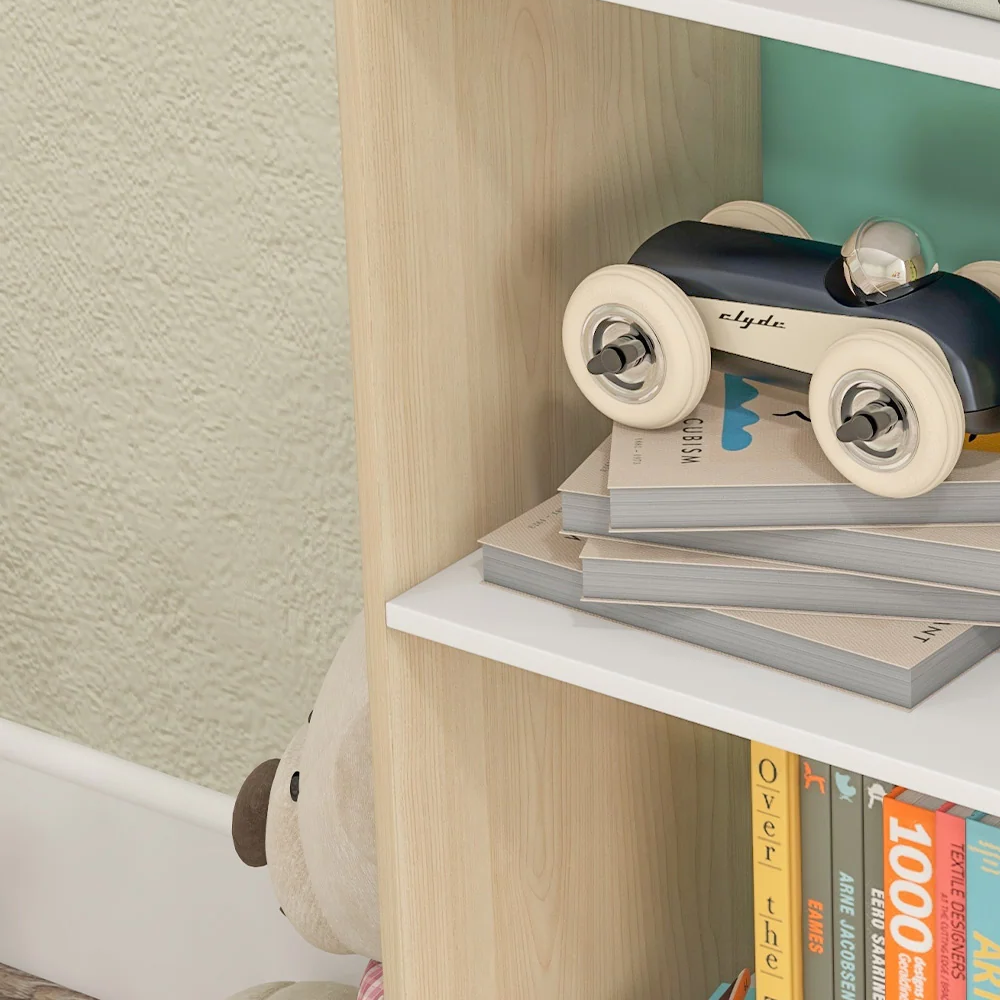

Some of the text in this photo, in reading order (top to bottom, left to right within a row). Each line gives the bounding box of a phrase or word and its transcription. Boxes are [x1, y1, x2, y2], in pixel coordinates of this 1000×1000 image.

[718, 310, 786, 329] clyde
[681, 417, 703, 464] CUBISM
[758, 758, 778, 970] Over the
[888, 816, 933, 954] 1000
[807, 898, 825, 955] EAMES
[839, 871, 856, 1000] ARNE JACOBSEN
[870, 888, 885, 930] EERO
[940, 905, 949, 919] THE
[950, 842, 966, 981] TEXTILE DESIGNERS
